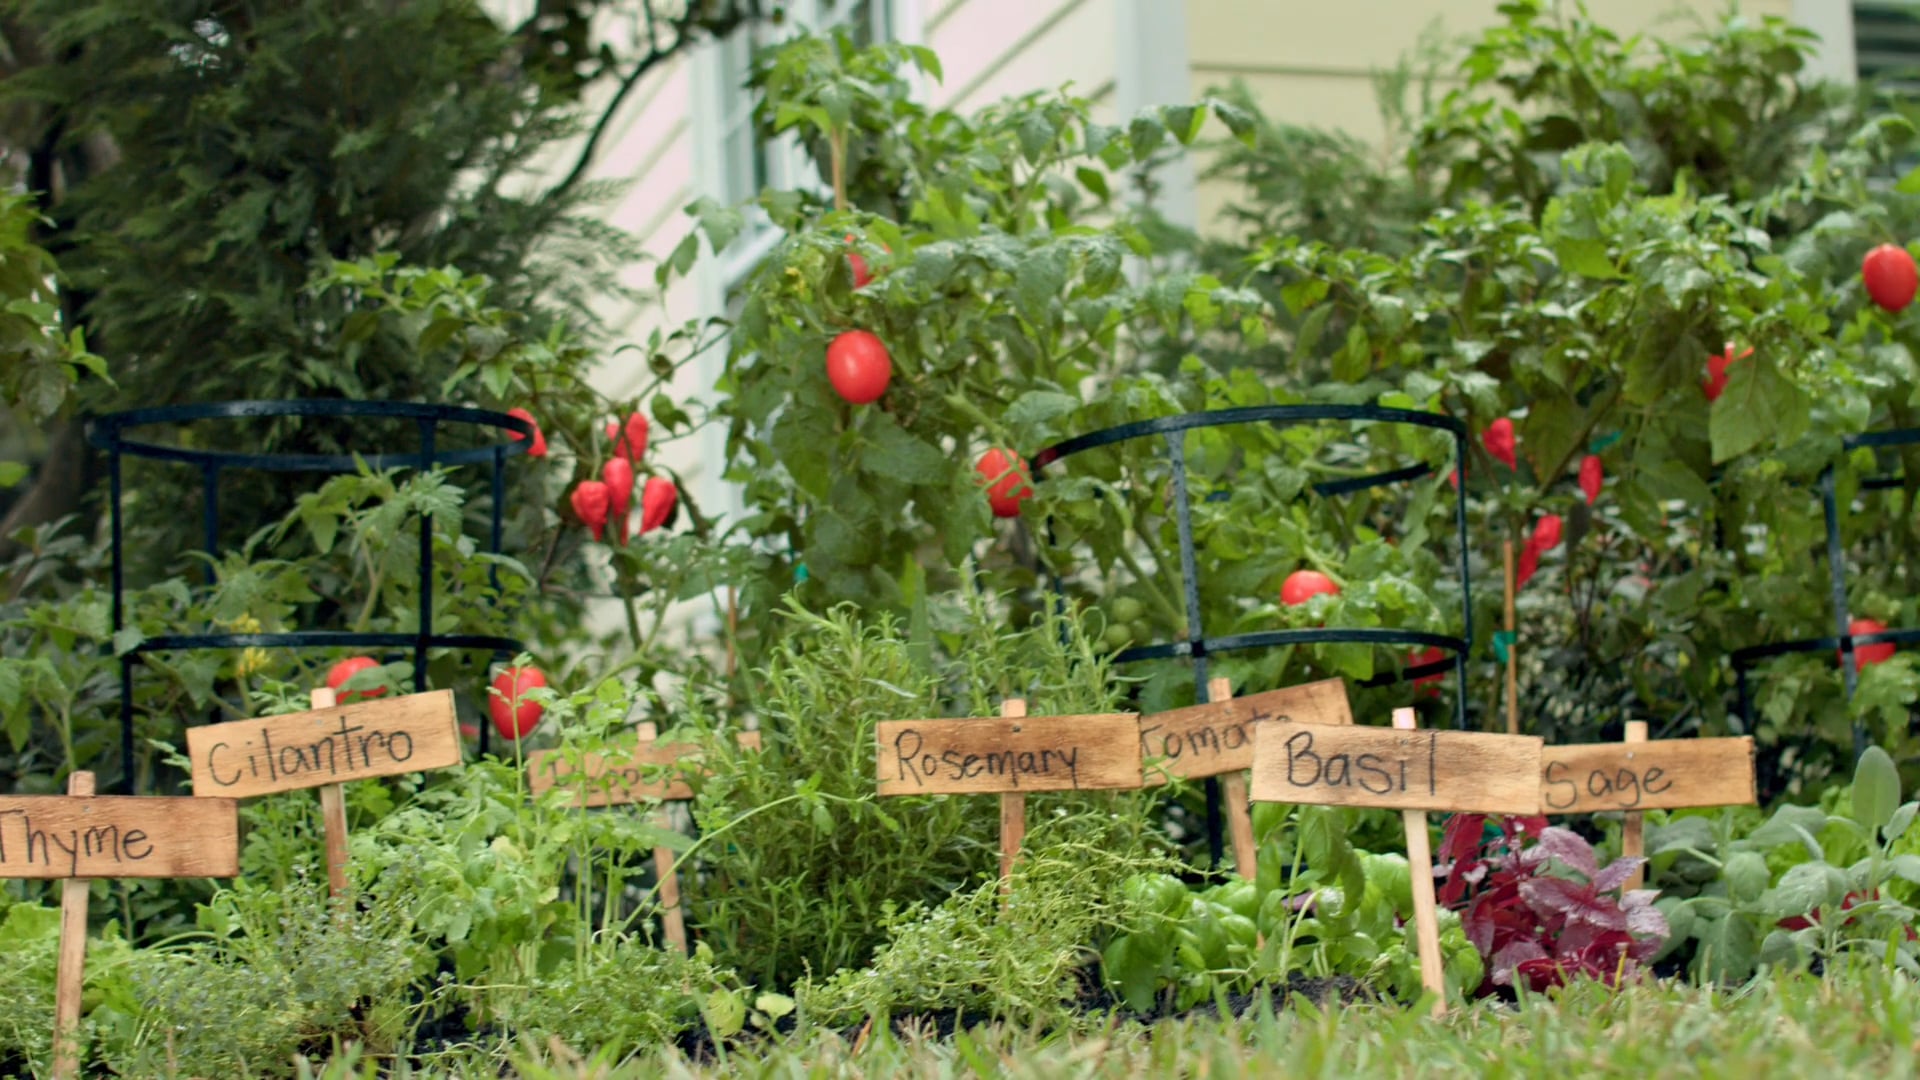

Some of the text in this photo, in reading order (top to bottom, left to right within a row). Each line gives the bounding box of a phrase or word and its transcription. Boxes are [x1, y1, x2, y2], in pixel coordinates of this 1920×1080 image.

[208, 715, 414, 787] Cilantro
[894, 728, 1079, 789] Rosemary
[1141, 706, 1291, 759] Tomat
[1284, 727, 1437, 797] Basil
[1543, 760, 1674, 810] Sage
[0, 808, 155, 878] Thyme
